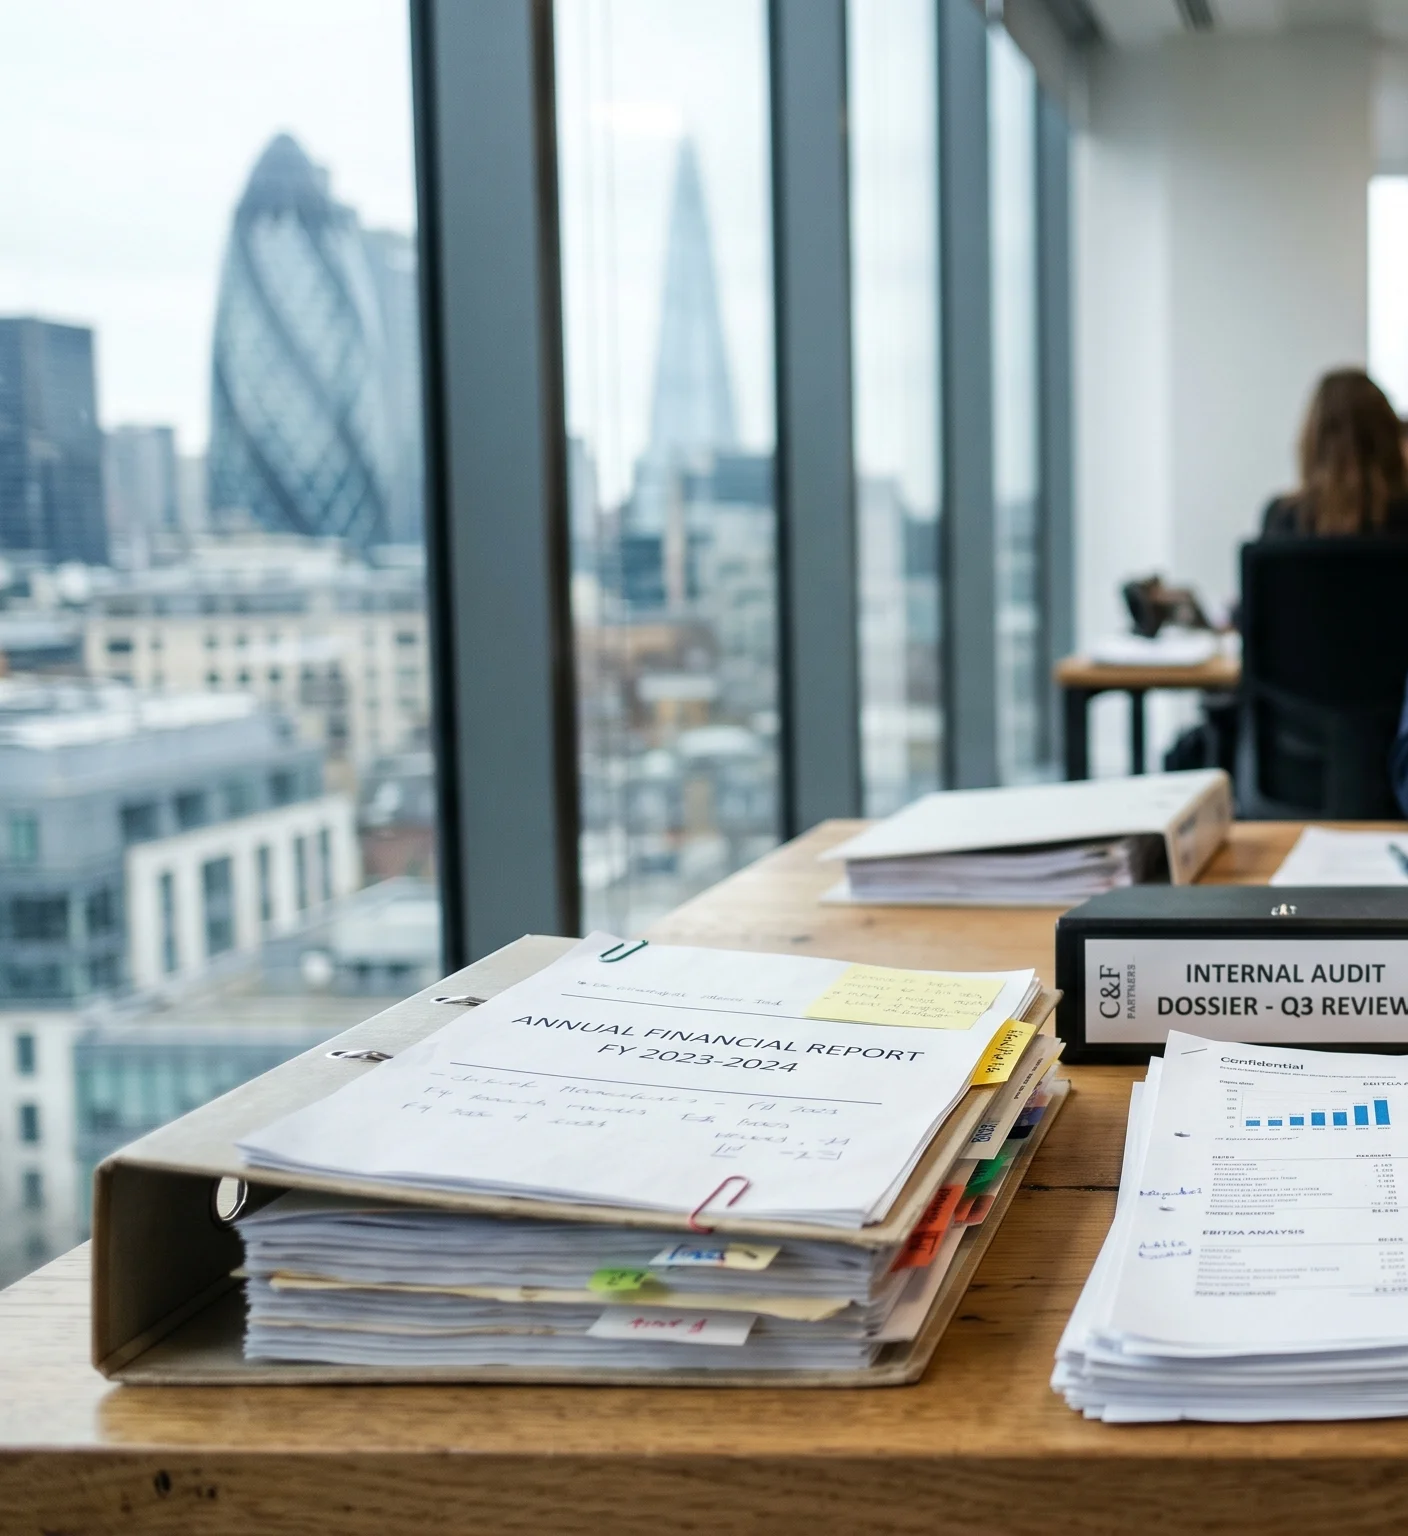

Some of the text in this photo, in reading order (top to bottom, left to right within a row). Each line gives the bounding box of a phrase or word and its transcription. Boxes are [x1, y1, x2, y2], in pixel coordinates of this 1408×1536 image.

[1186, 963, 1386, 984] INTERNAL AUDIT
[1100, 965, 1121, 1019] C&F
[1127, 964, 1136, 1019] PARTNERS
[1157, 996, 1258, 1017] DOSSIER
[1281, 996, 1314, 1018] Q3
[511, 1015, 926, 1062] ANNUAL FINANCIAL REPORT
[598, 1043, 799, 1073] FY 2023-2024
[1247, 1228, 1306, 1236] ANALYSIS
